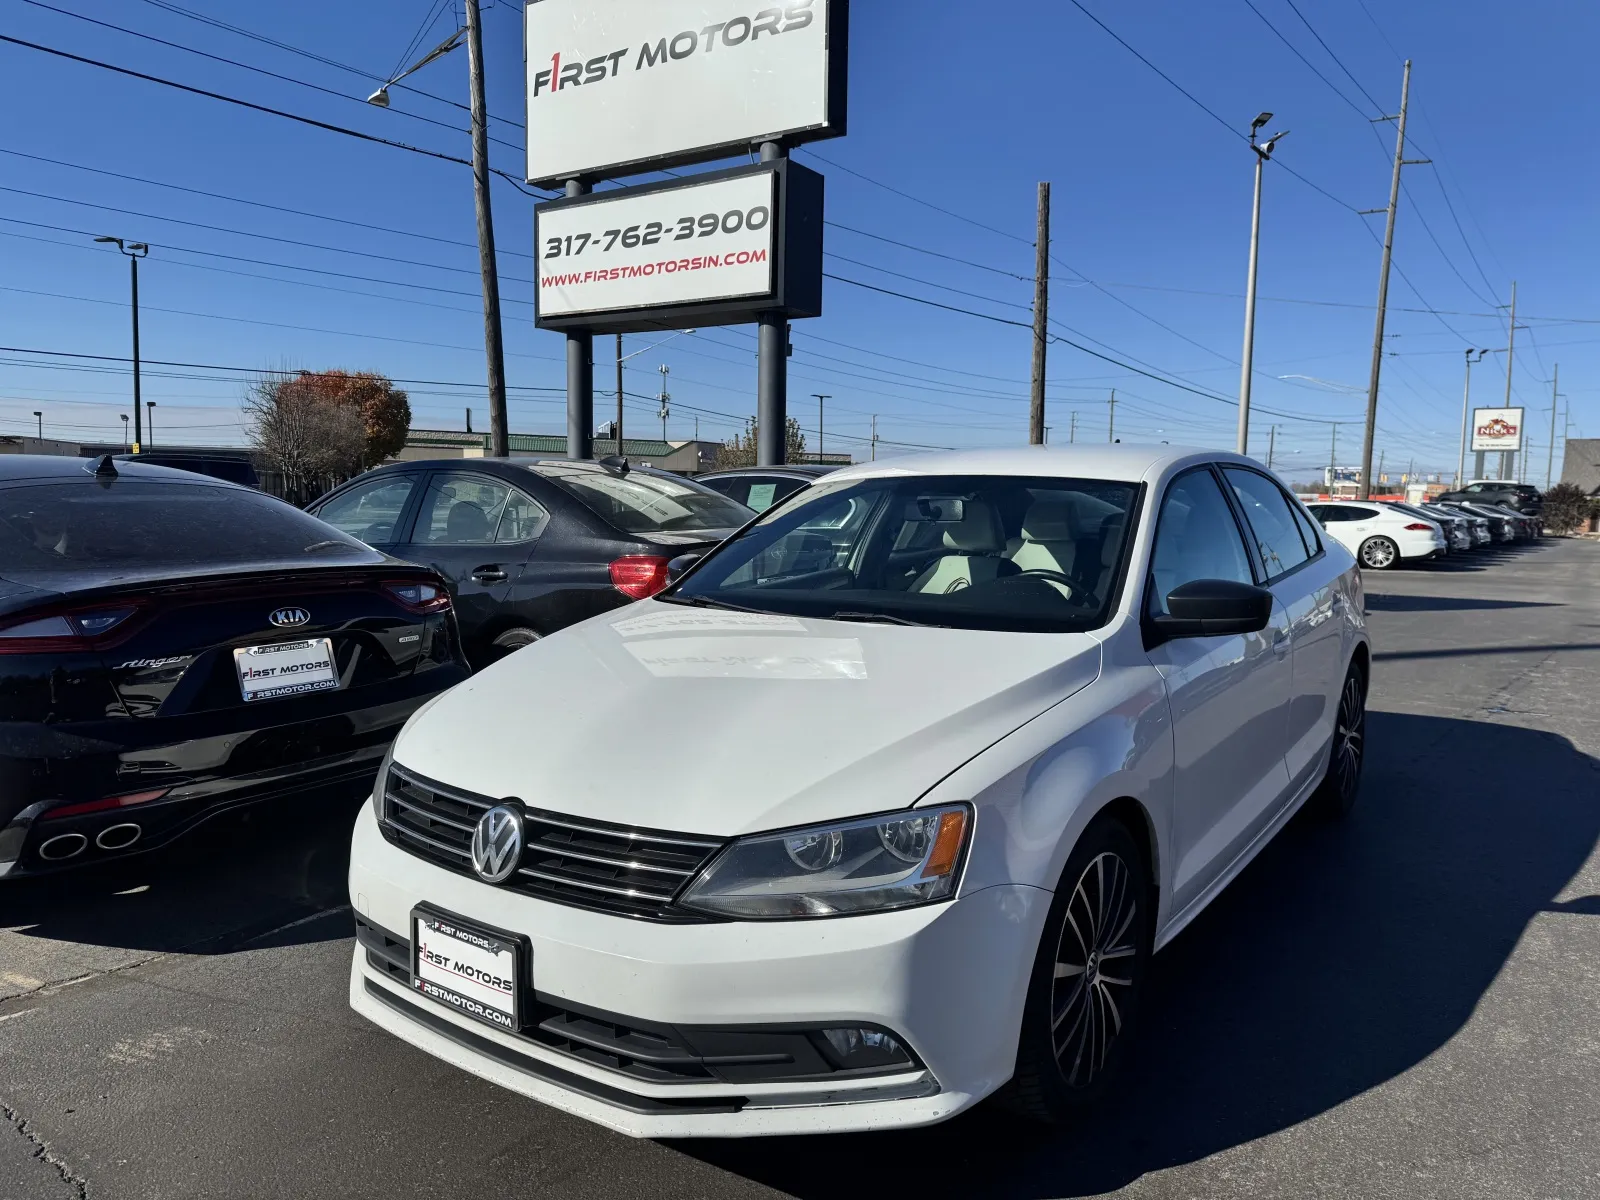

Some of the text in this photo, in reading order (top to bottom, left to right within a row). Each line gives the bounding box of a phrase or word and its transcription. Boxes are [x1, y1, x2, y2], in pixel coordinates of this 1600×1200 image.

[636, 0, 814, 70] MOTORS
[544, 205, 769, 260] 317-762-3900
[541, 249, 766, 288] WWW.FIRSTMOTORSIN.COM
[275, 609, 306, 624] KIA
[279, 642, 308, 653] MOTORS
[280, 660, 330, 675] MOTORS
[455, 929, 489, 948] MOTORS
[453, 961, 513, 992] MOTORS
